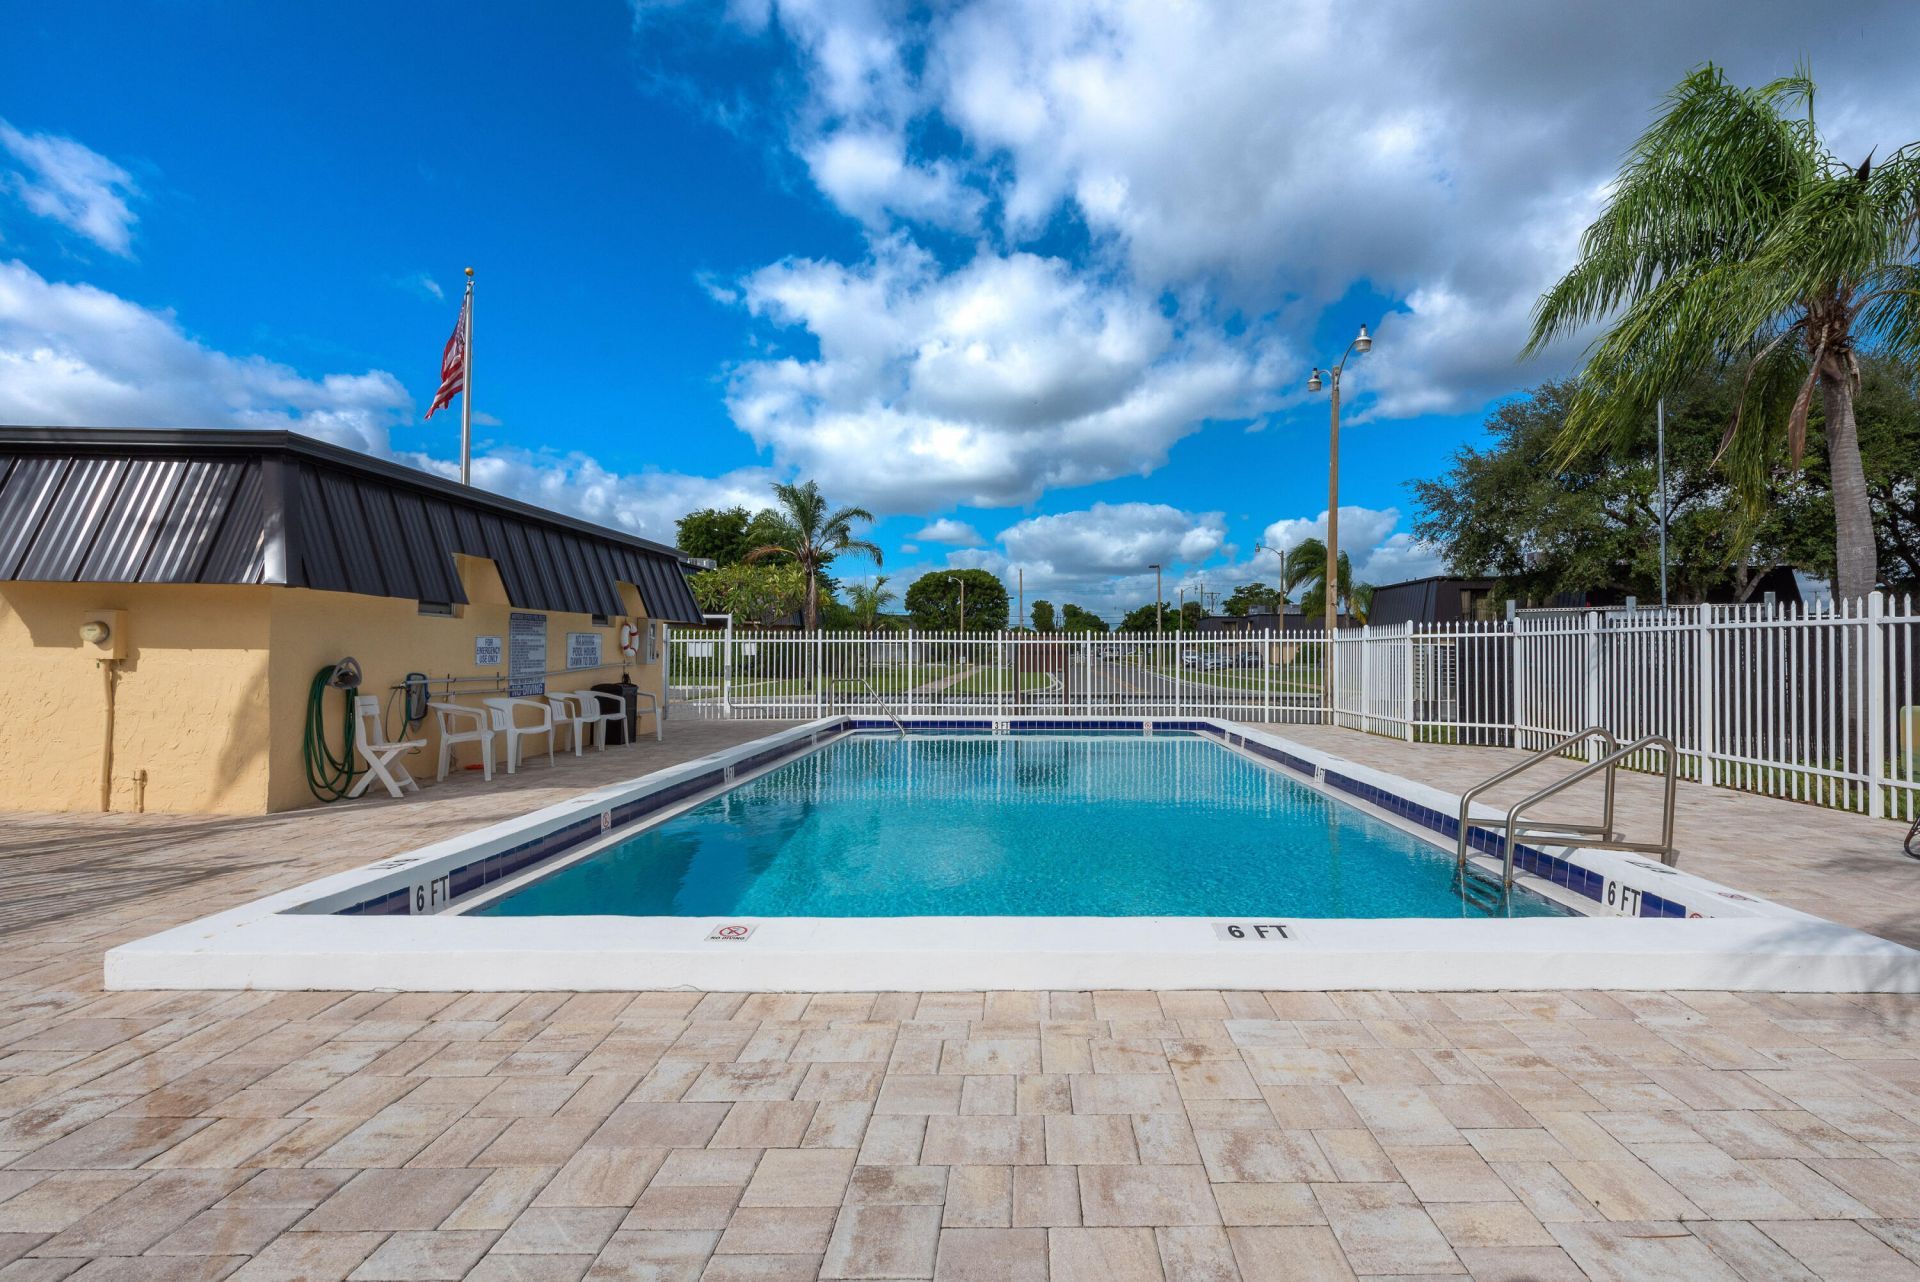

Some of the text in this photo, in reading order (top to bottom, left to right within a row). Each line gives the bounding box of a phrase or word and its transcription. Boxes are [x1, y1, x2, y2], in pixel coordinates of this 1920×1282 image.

[485, 638, 493, 646] FOR
[476, 646, 500, 655] EMERGENCY
[488, 655, 498, 663] ONLY
[523, 683, 543, 695] DIVING
[416, 874, 449, 912] 6 FT
[1607, 880, 1641, 916] 6 FT
[1227, 925, 1289, 939] 6 FT
